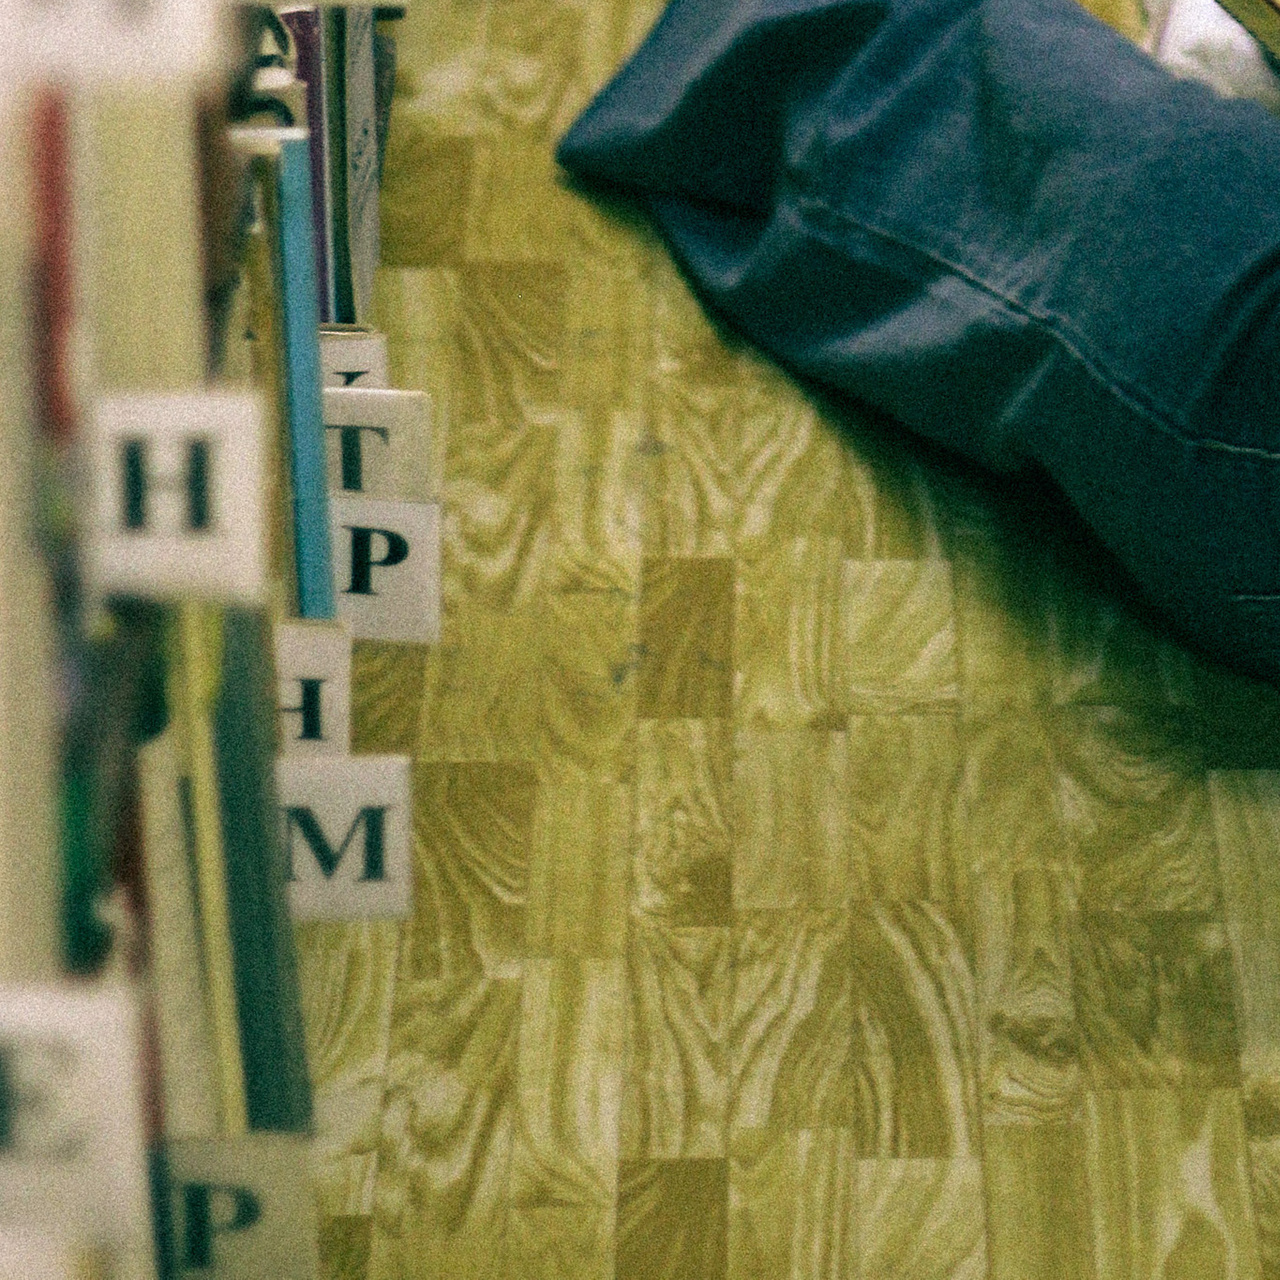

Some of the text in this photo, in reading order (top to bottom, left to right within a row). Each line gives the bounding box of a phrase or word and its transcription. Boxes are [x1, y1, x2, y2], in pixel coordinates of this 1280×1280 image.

[117, 436, 213, 533] Н
[325, 424, 390, 492] Т
[342, 525, 410, 596] Р
[281, 804, 392, 883] М
[178, 1181, 263, 1272] Р
